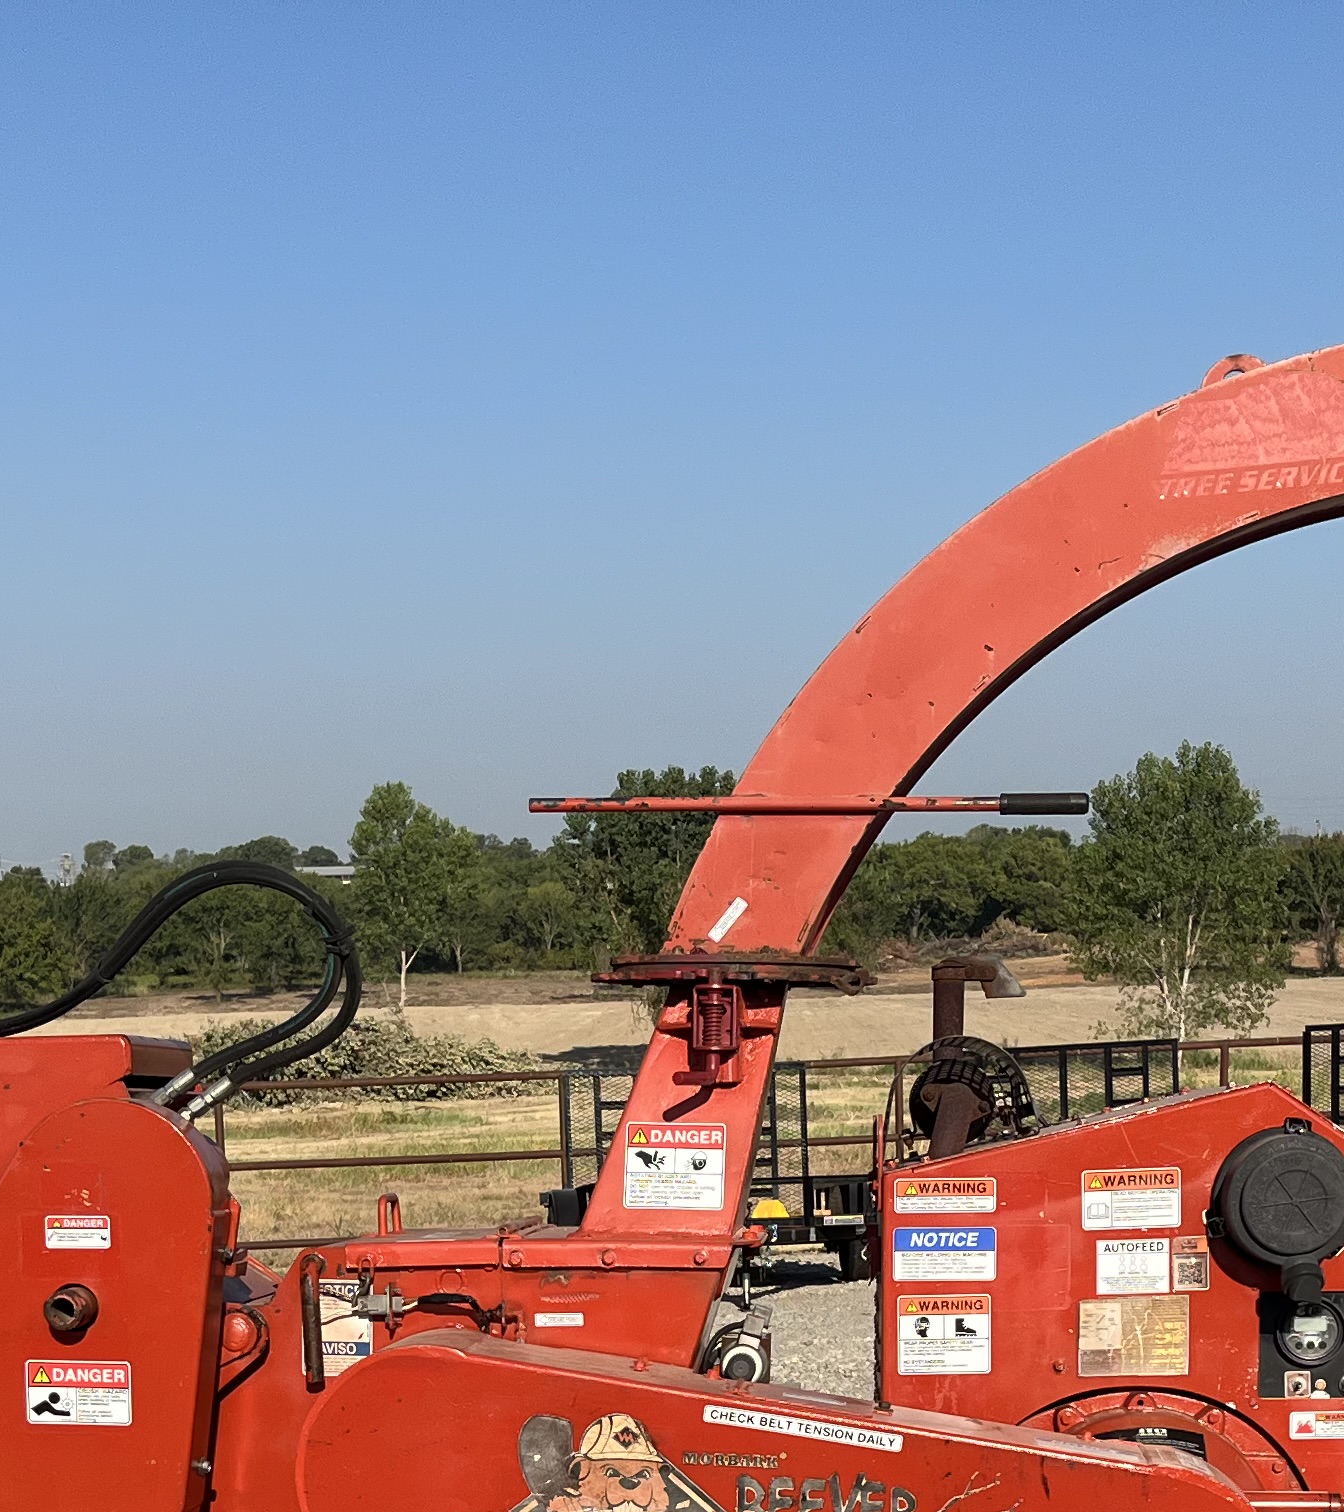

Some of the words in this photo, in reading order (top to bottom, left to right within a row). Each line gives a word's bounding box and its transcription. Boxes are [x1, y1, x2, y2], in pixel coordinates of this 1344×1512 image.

[1160, 473, 1234, 497] TREE
[649, 1129, 723, 1144] DANGER
[1102, 1173, 1175, 1187] WARNING
[918, 1182, 987, 1194] WARNING
[64, 1219, 104, 1228] DANGER
[909, 1231, 980, 1248] NOTICE
[1103, 1241, 1164, 1253] AUTOFEED
[918, 1299, 984, 1311] WARNING
[52, 1367, 126, 1383] DANGER
[710, 1409, 755, 1425] CHECK
[759, 1416, 793, 1430] BELT
[797, 1422, 854, 1441] TENSION
[857, 1432, 896, 1448] DAILY
